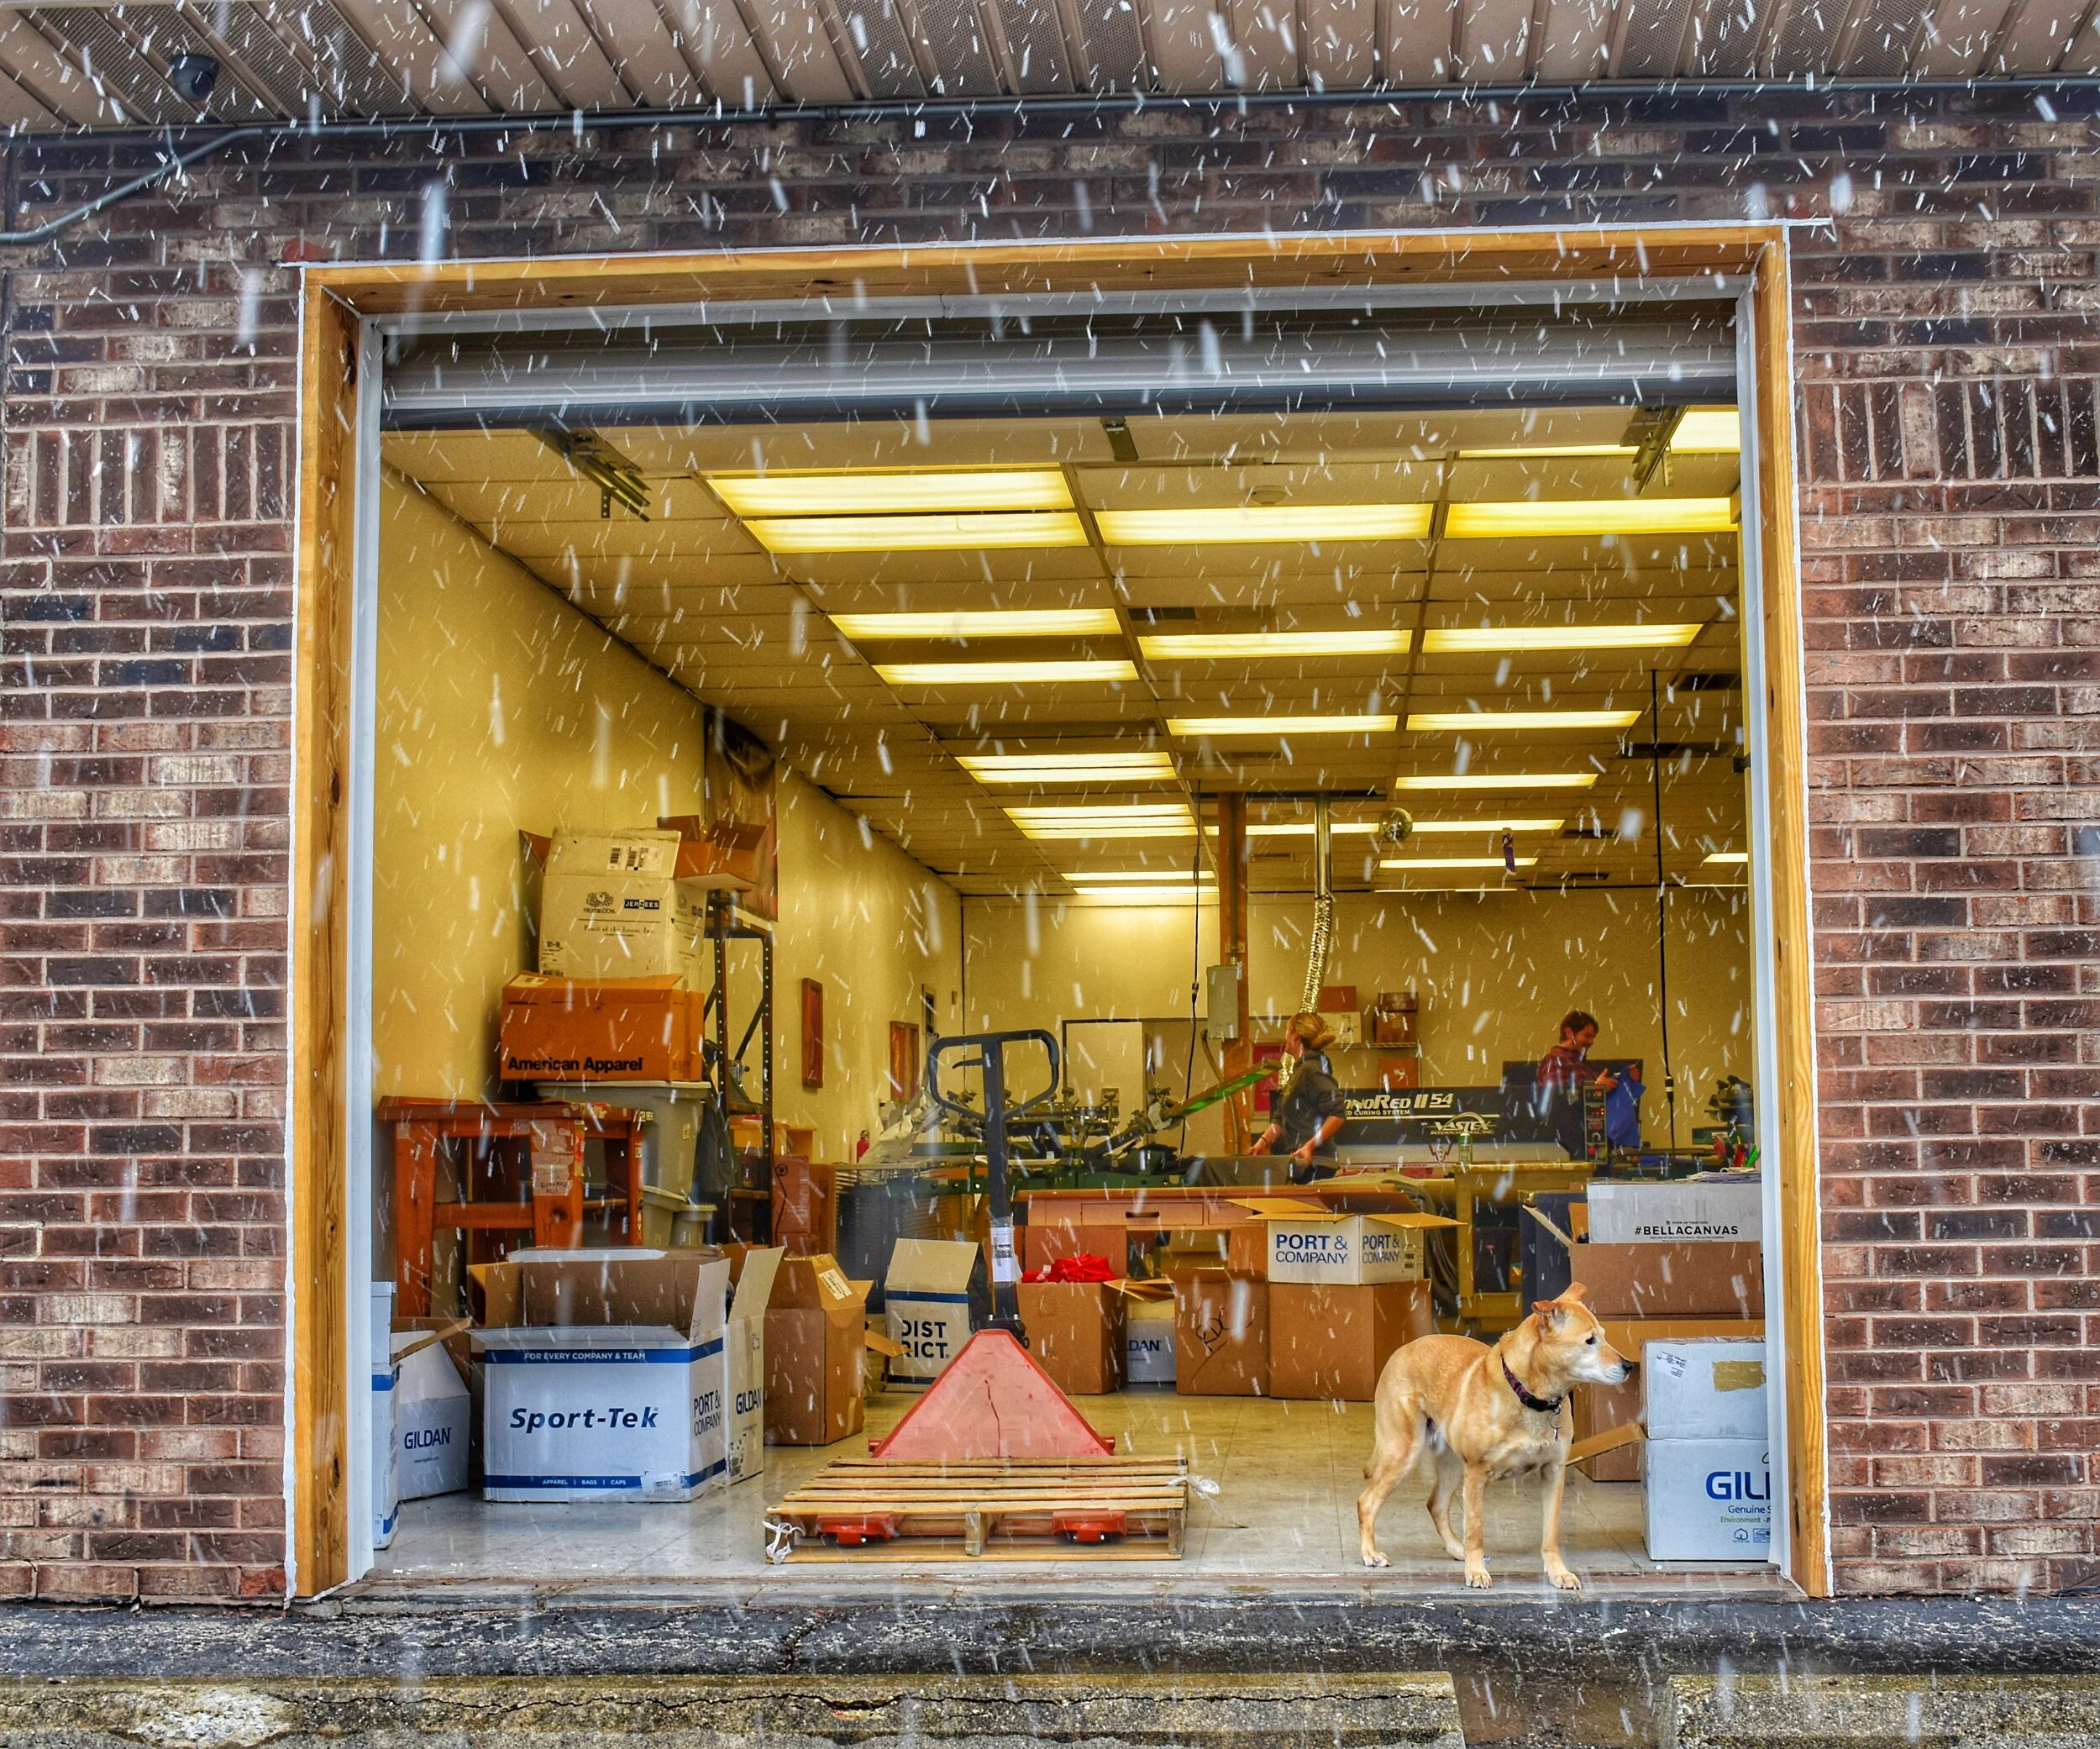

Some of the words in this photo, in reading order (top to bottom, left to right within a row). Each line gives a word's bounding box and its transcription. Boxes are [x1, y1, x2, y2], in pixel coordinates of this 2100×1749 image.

[625, 900, 659, 909] JERZEES
[507, 1057, 580, 1071] American
[583, 1057, 643, 1073] Apparel
[1430, 1093, 1454, 1105] 54
[1435, 1121, 1491, 1132] VASTEX
[1635, 1226, 1739, 1236] #BELLACANVAS
[1276, 1234, 1330, 1250] PORT
[1334, 1235, 1348, 1251] &
[1362, 1234, 1391, 1250] PORT
[1393, 1233, 1400, 1248] &
[1276, 1251, 1348, 1264] COMPANY
[1362, 1251, 1399, 1264] COMPANY
[1128, 1340, 1160, 1352] DAN
[694, 1391, 714, 1418] PORT
[715, 1389, 721, 1408] &
[736, 1388, 762, 1415] GILDAN
[510, 1406, 659, 1434] Sport-Tek
[694, 1410, 722, 1436] COMPANY
[404, 1427, 450, 1450] GILDAN
[1728, 1505, 1765, 1514] Genuine
